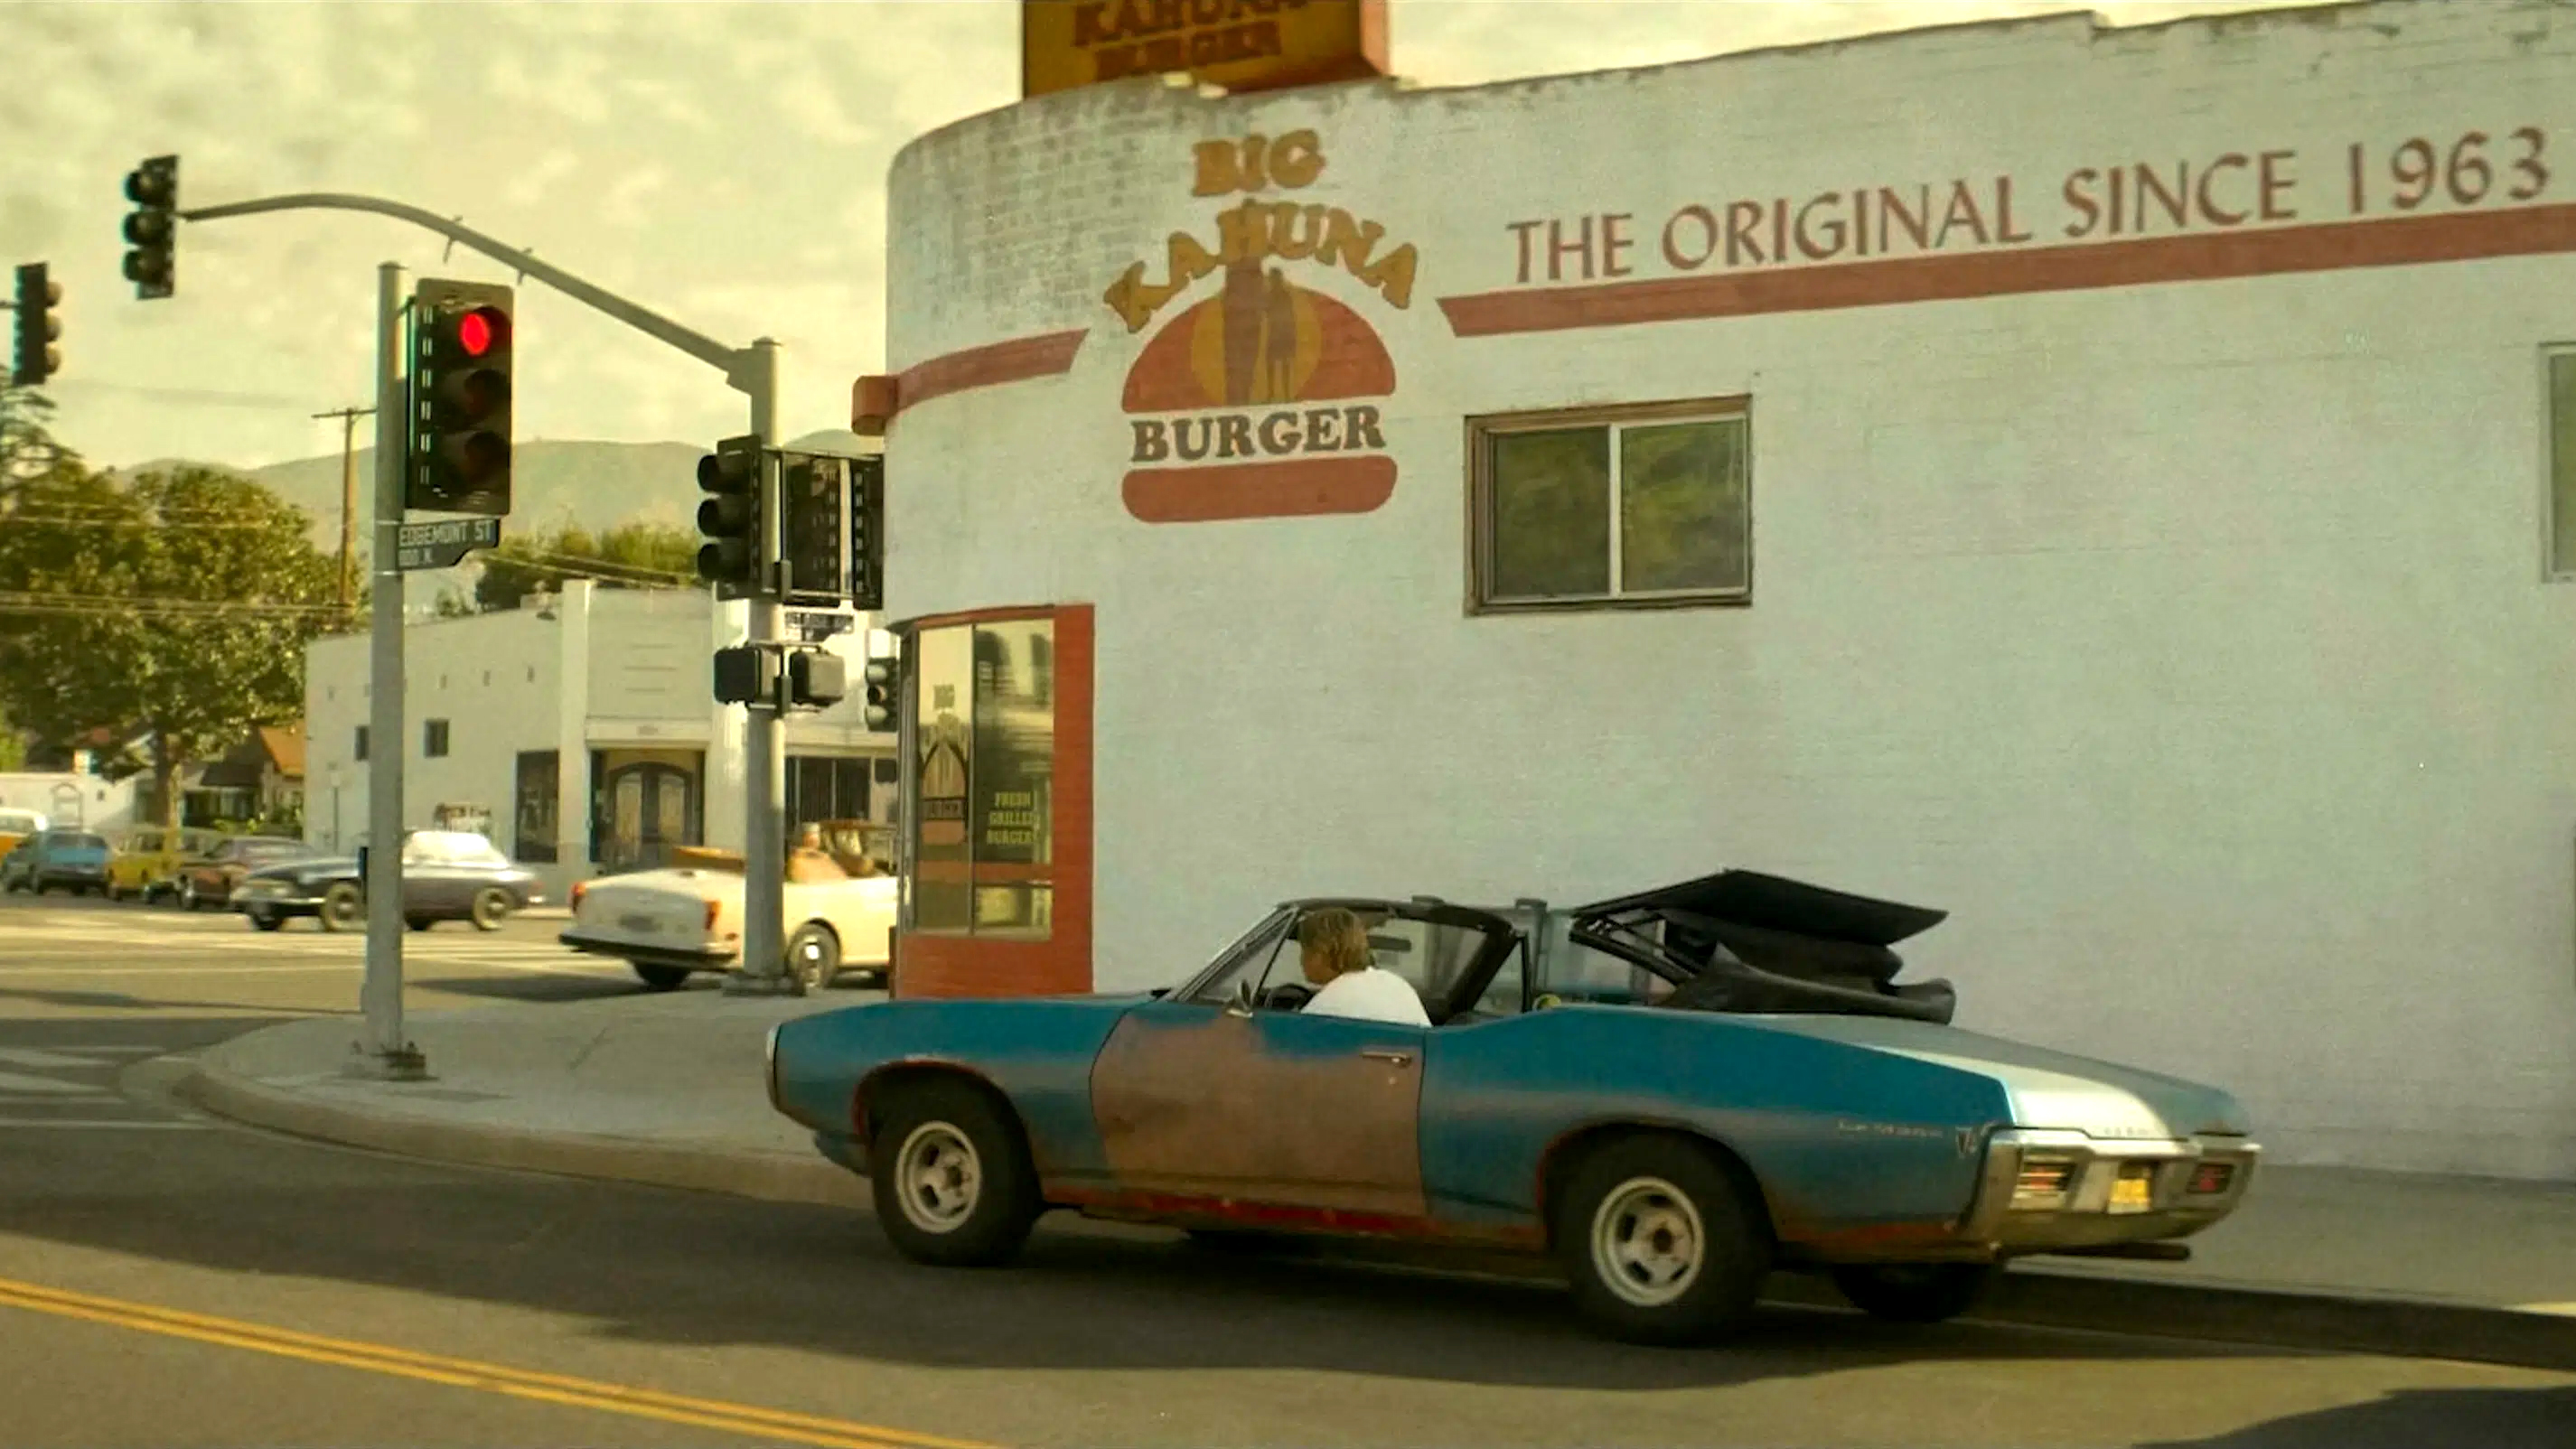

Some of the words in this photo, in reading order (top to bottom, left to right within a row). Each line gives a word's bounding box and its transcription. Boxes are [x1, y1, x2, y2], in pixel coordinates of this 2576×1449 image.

[1192, 128, 1326, 197] BIG
[1505, 213, 1635, 283] THE
[1661, 175, 2033, 270] ORIGINAL
[2062, 150, 2298, 238] SINCE
[2348, 126, 2551, 215] 1963
[1103, 200, 1418, 333] KAHUNA
[1129, 405, 1387, 463] BURGER
[398, 522, 468, 547] EDGEMONT
[473, 519, 493, 541] ST
